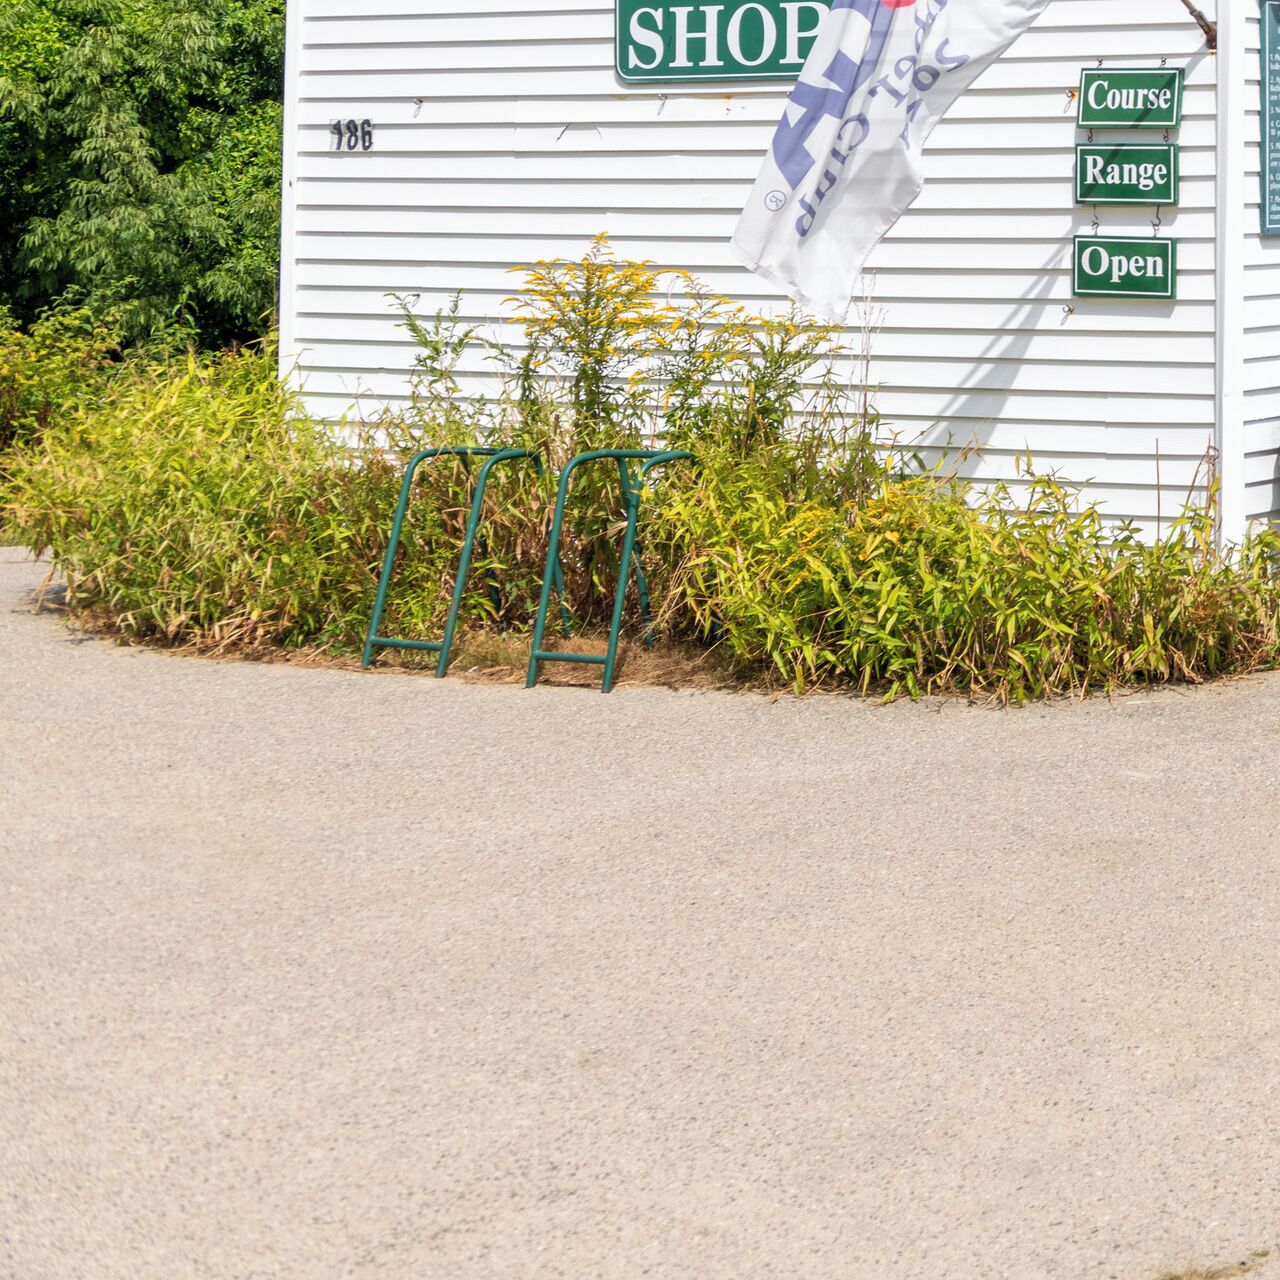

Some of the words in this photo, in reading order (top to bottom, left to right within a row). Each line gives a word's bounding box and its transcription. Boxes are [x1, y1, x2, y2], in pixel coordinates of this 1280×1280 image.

[628, 1, 830, 70] SHOP
[1087, 80, 1171, 110] Course
[1083, 155, 1168, 191] Range
[1081, 246, 1164, 283] Open
